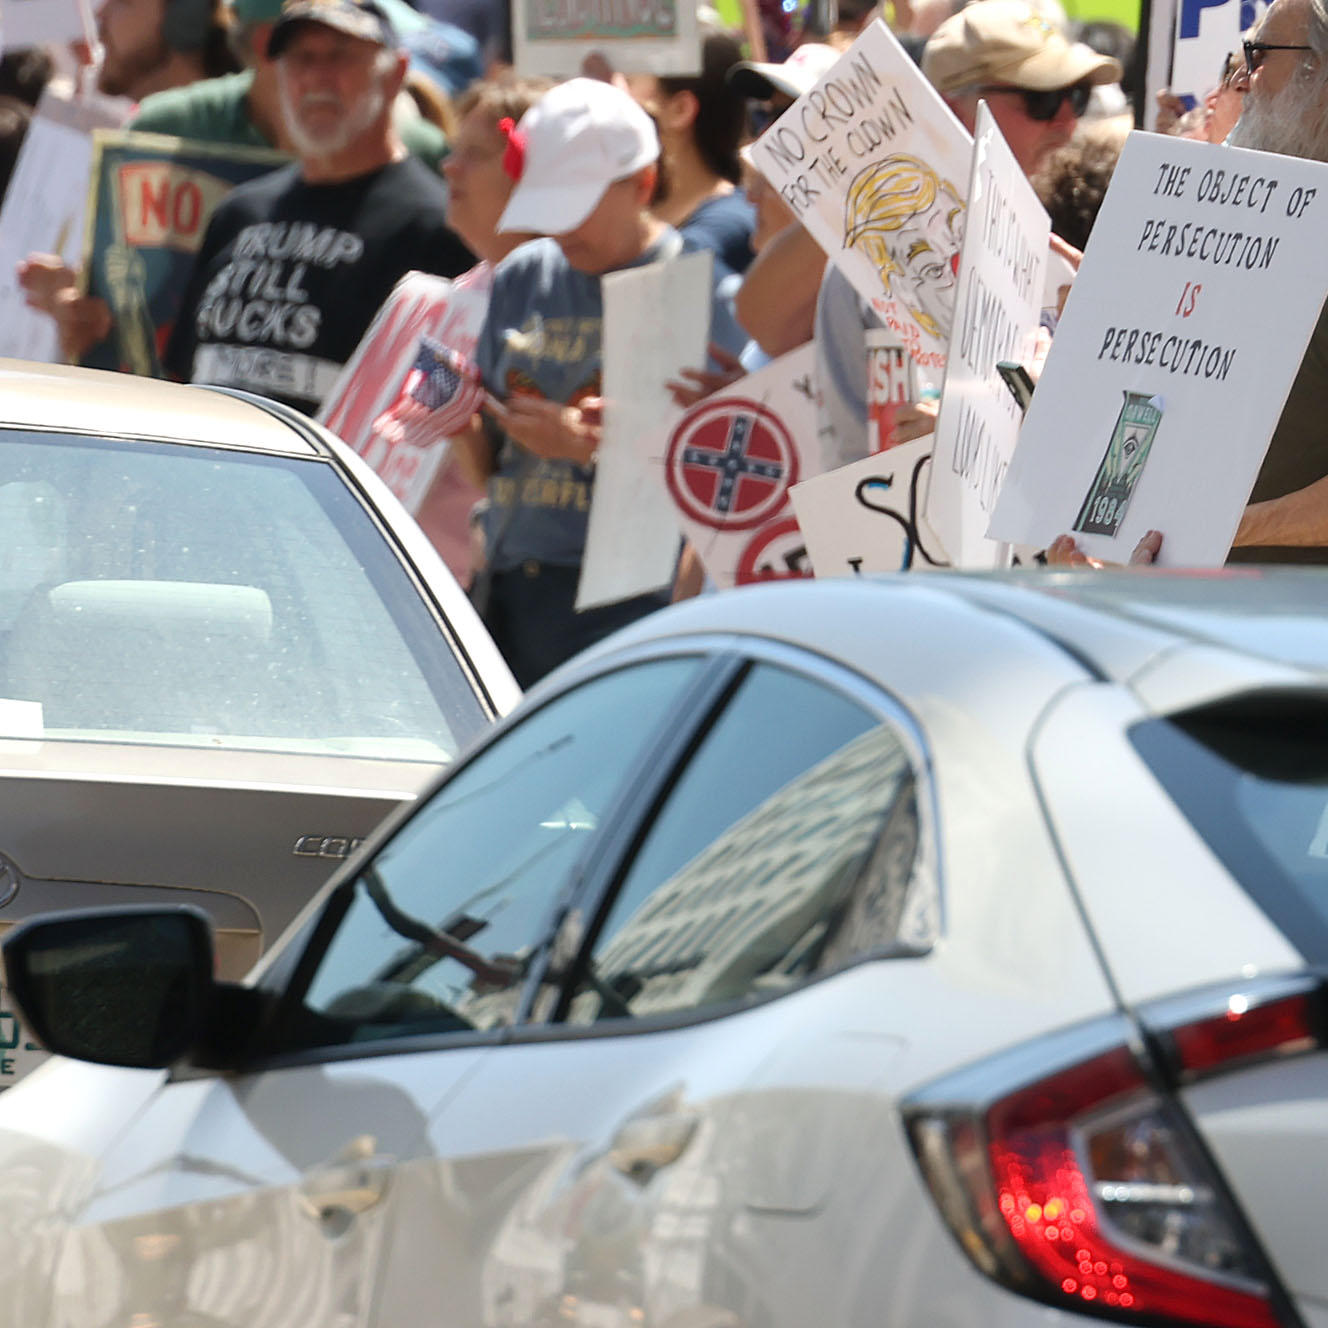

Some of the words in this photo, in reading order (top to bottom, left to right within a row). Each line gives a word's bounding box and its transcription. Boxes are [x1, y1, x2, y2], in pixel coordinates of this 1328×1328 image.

[765, 129, 804, 174] NO
[801, 52, 883, 144] CROWN
[781, 175, 820, 218] FOR
[808, 149, 847, 189] THE
[847, 88, 912, 159] CLOWN
[141, 180, 203, 236] NO
[1153, 163, 1190, 199] THE
[1198, 171, 1279, 215] OBJECT
[1286, 187, 1317, 219] OF
[1138, 220, 1280, 270] PERSECUTION
[1178, 281, 1199, 319] IS
[1100, 326, 1235, 382] PERSECUTION
[1089, 496, 1128, 528] 1984
